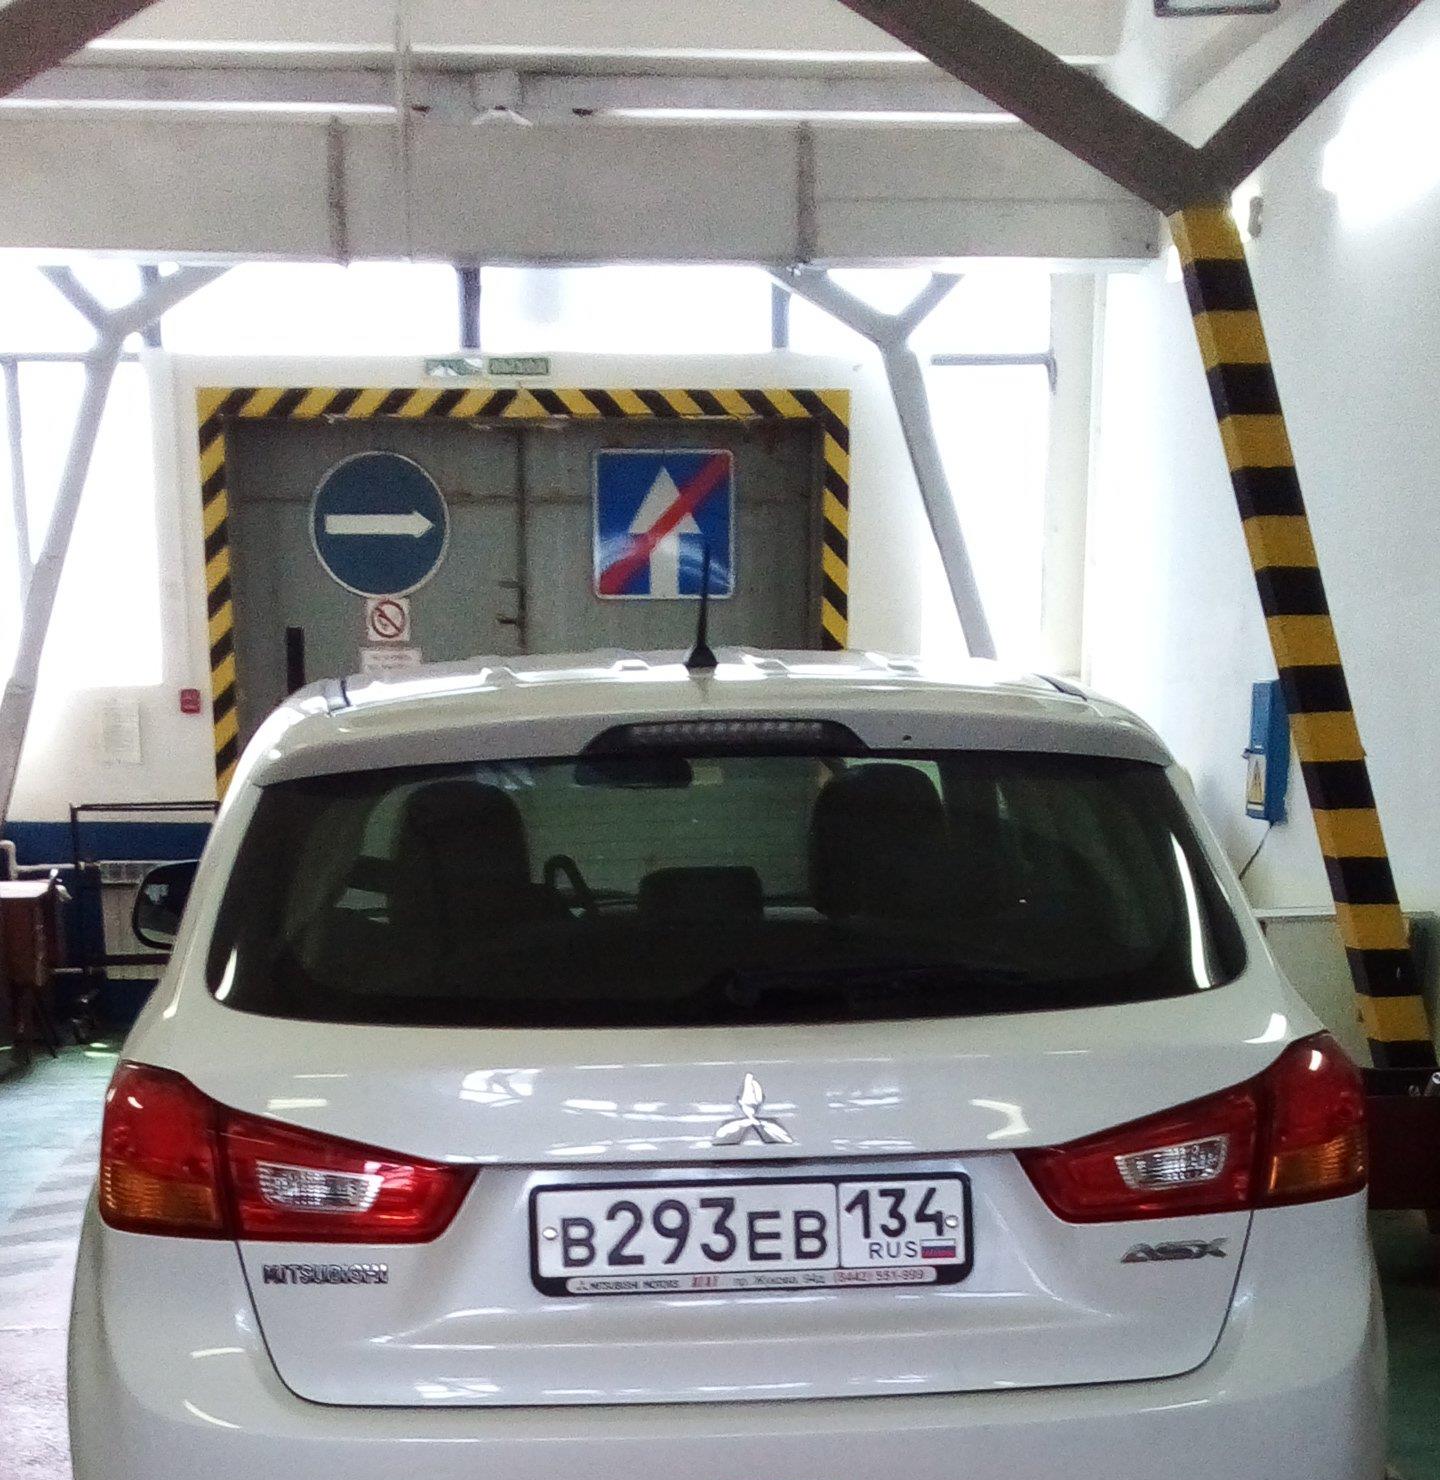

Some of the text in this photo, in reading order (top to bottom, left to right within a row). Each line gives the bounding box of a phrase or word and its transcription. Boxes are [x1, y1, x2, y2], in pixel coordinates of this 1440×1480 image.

[562, 1187, 945, 1267] В293ЕВ 134
[868, 1241, 918, 1259] RUS
[1120, 1237, 1229, 1263] ASX
[263, 1264, 389, 1284] MITSUBISHI
